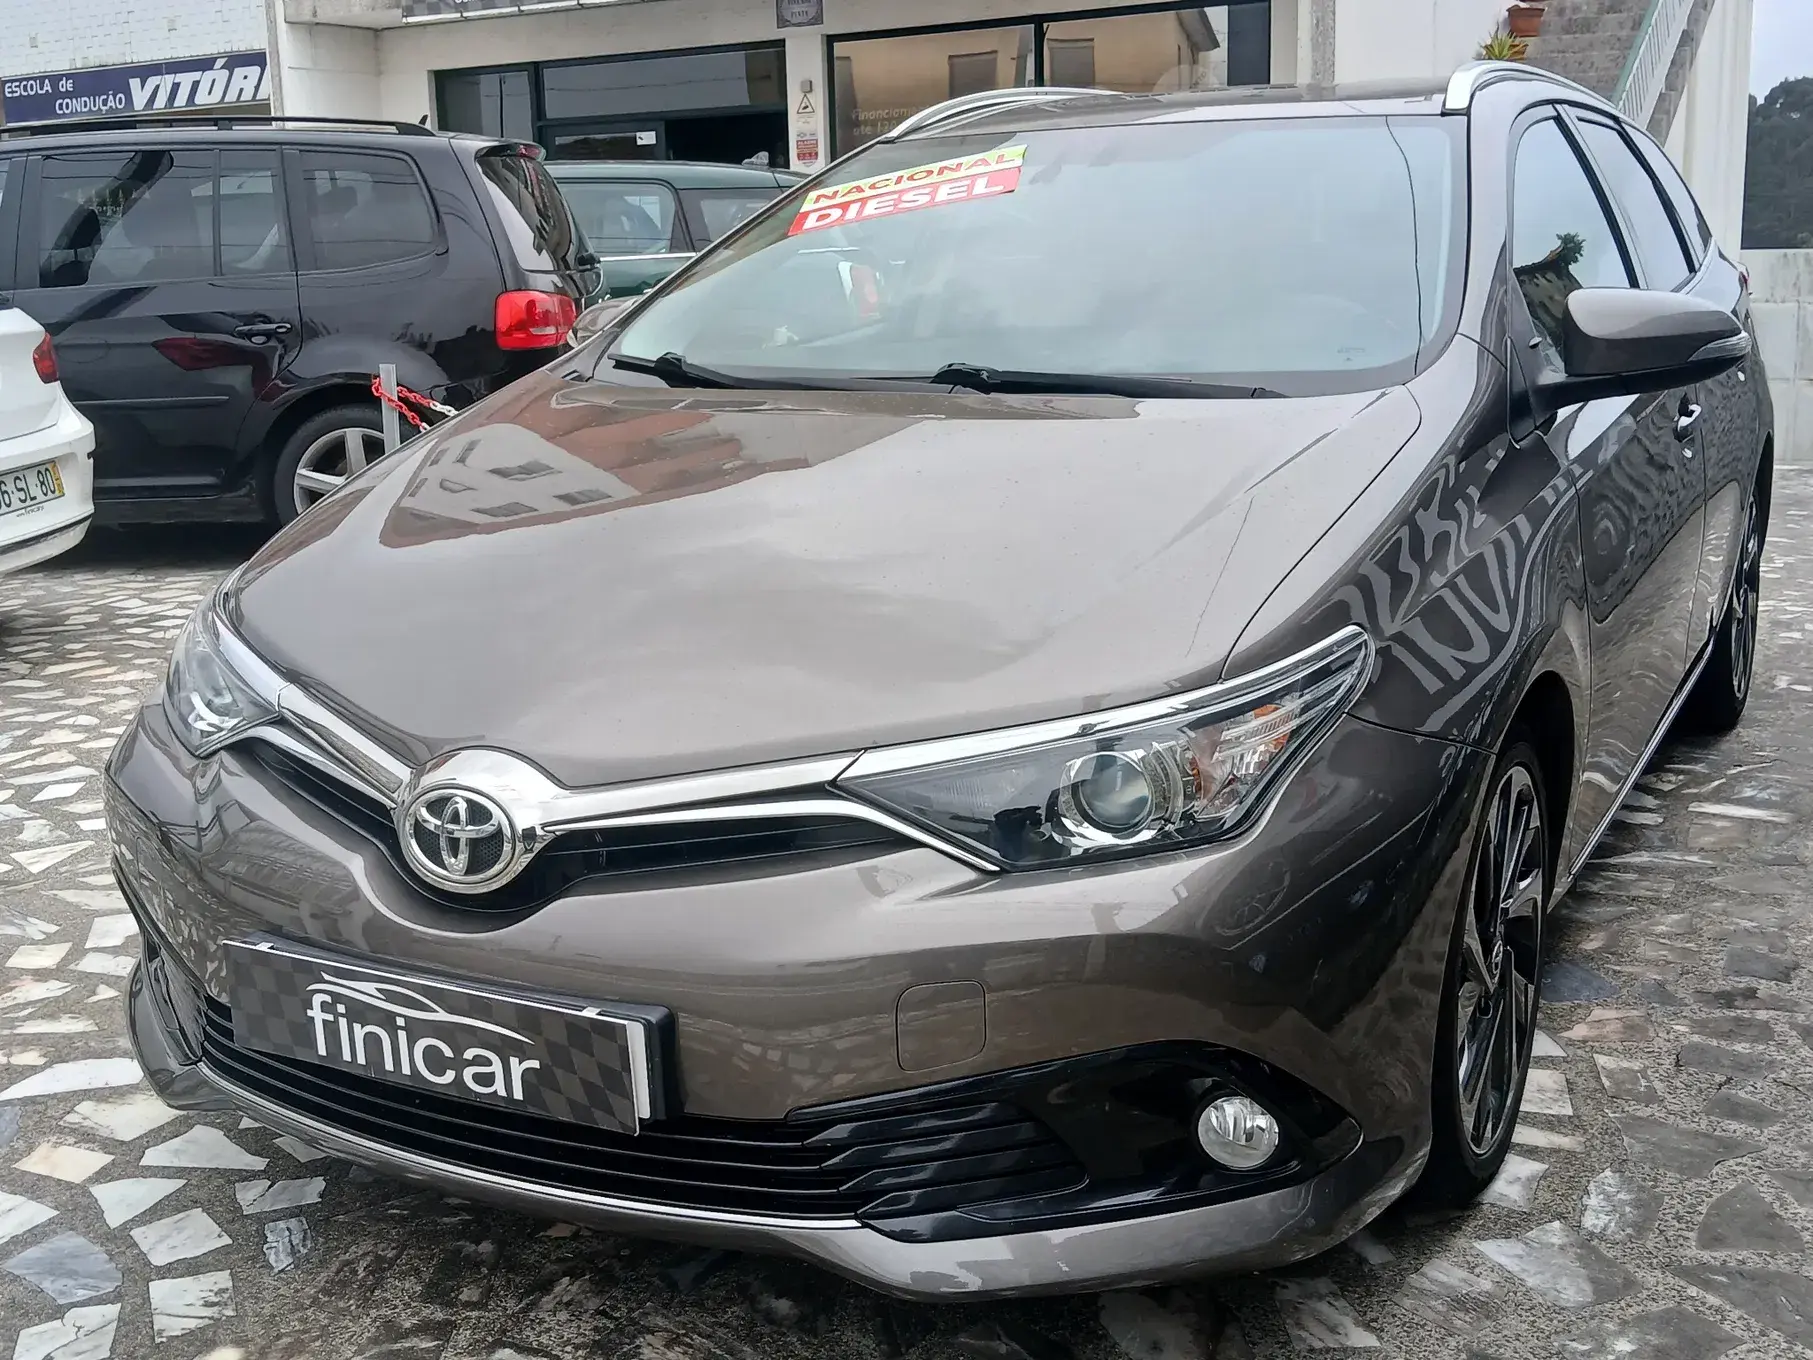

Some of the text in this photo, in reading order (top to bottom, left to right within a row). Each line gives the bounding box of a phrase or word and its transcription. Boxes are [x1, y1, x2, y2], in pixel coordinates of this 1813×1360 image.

[5, 77, 74, 98] ESCOLA de
[55, 91, 126, 114] CONDUÇÃO
[128, 57, 271, 111] VITÓRI
[802, 175, 1006, 231] DIESEL
[813, 153, 1015, 205] NACIONAL
[306, 992, 540, 1101] finicar
